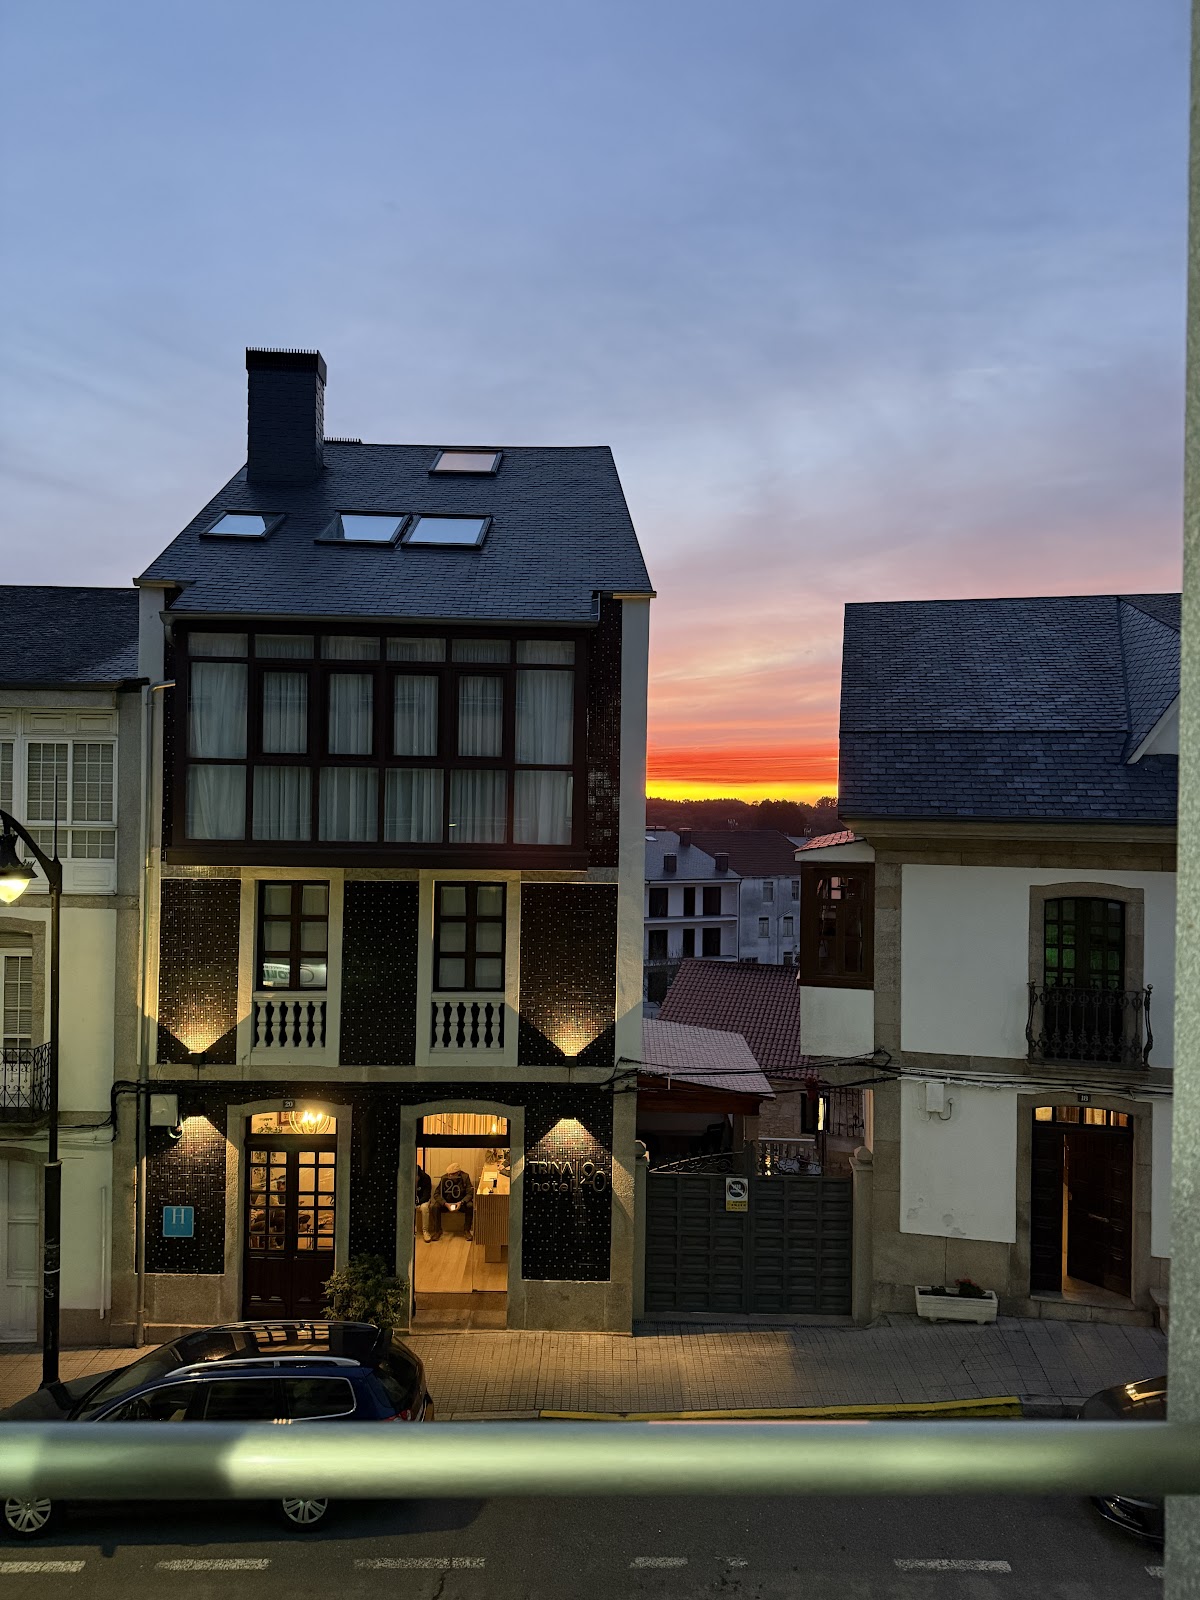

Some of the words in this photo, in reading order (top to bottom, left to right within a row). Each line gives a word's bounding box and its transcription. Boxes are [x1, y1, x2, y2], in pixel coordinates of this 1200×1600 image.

[532, 1179, 573, 1192] hotel
[580, 1162, 607, 1193] 20
[445, 1180, 460, 1198] 20
[171, 1208, 185, 1225] H
